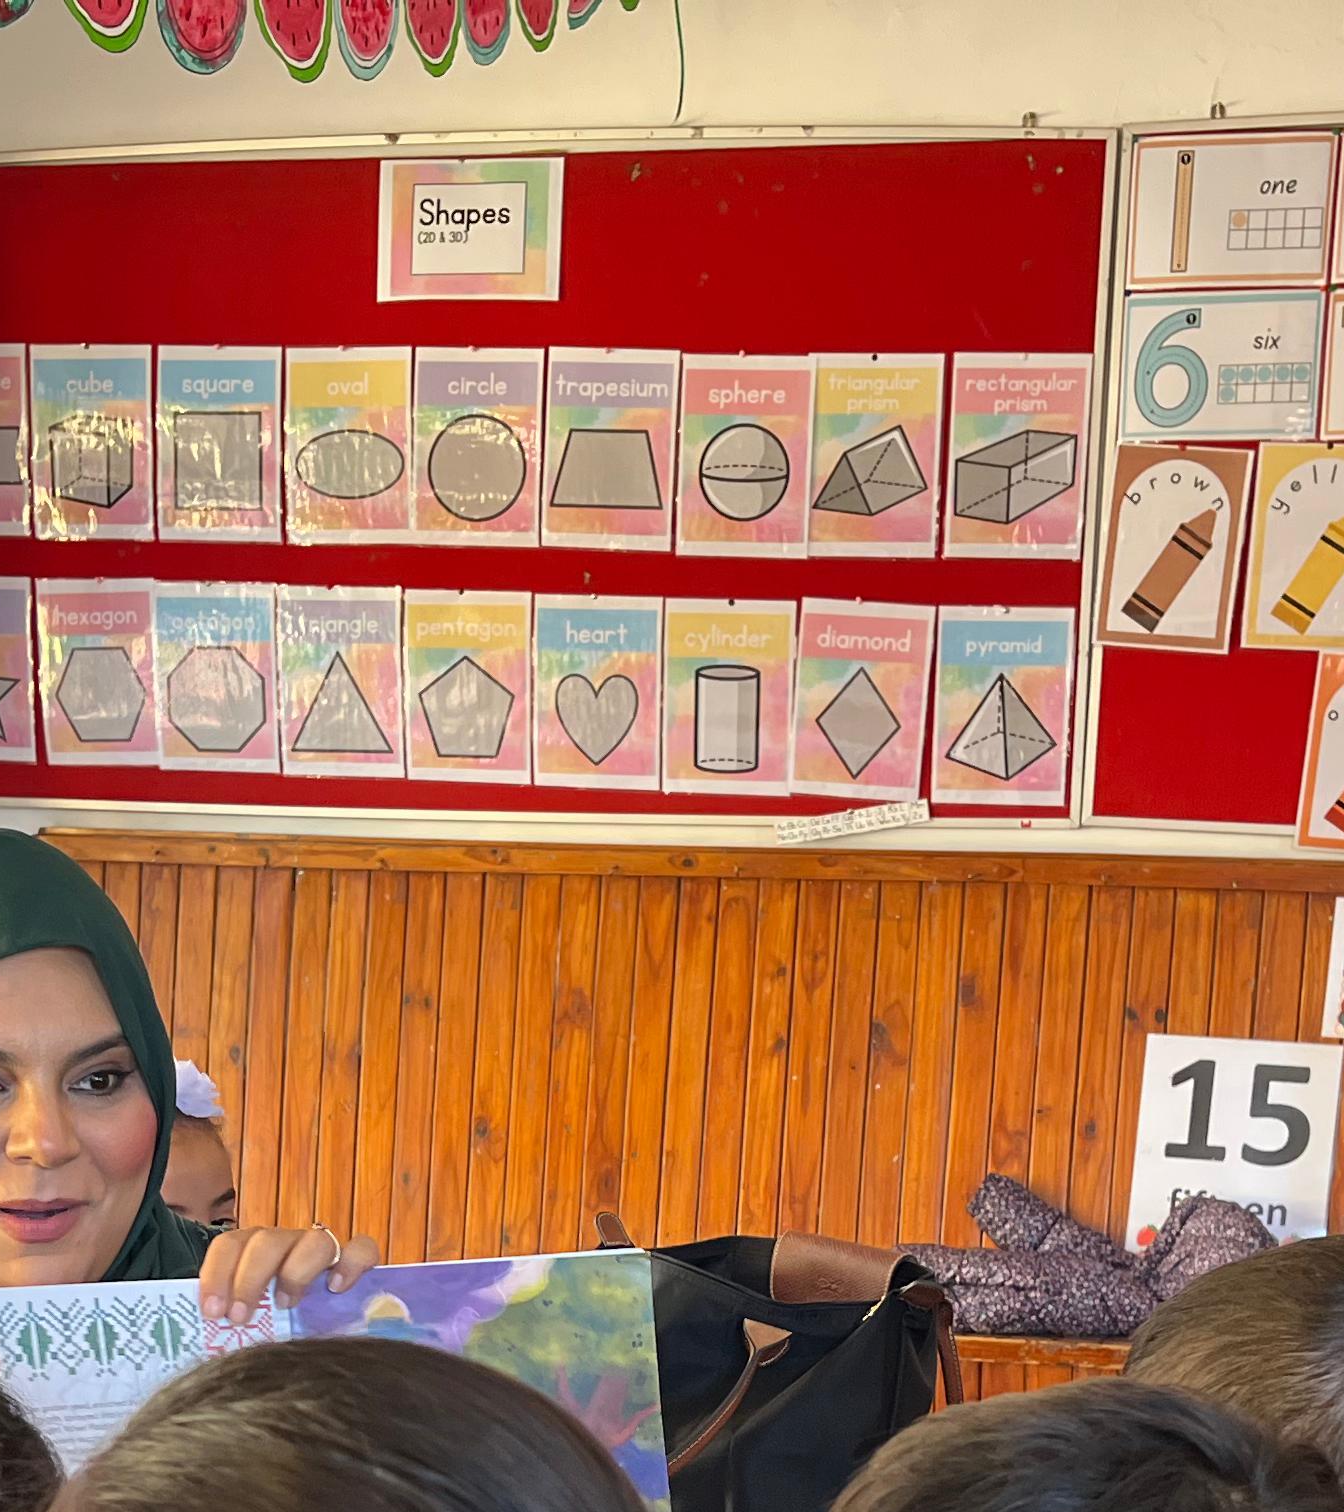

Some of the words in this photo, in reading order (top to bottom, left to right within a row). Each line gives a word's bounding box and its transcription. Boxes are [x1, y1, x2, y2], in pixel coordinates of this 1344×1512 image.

[1259, 176, 1298, 196] one
[420, 199, 510, 231] Shapes
[1170, 150, 1195, 273] 1
[1253, 328, 1281, 351] six
[1133, 308, 1209, 428] 6
[66, 371, 114, 394] cube
[182, 376, 254, 398] square
[326, 374, 369, 396] oval
[448, 373, 507, 396] circle
[556, 375, 669, 402] trapesium
[827, 374, 920, 398] triangular
[965, 375, 1078, 400] rectangular
[708, 385, 787, 412] sphere
[847, 394, 899, 414] prism
[994, 396, 1047, 415] prism
[1123, 472, 1225, 512] brown
[55, 604, 137, 629] hexagon
[299, 608, 378, 639] riangle
[416, 617, 517, 642] pentagon
[565, 623, 629, 646] heart
[816, 626, 911, 654] diamond
[684, 628, 771, 659] cylinder
[965, 632, 1043, 657] pyramid
[1164, 1059, 1312, 1168] 15
